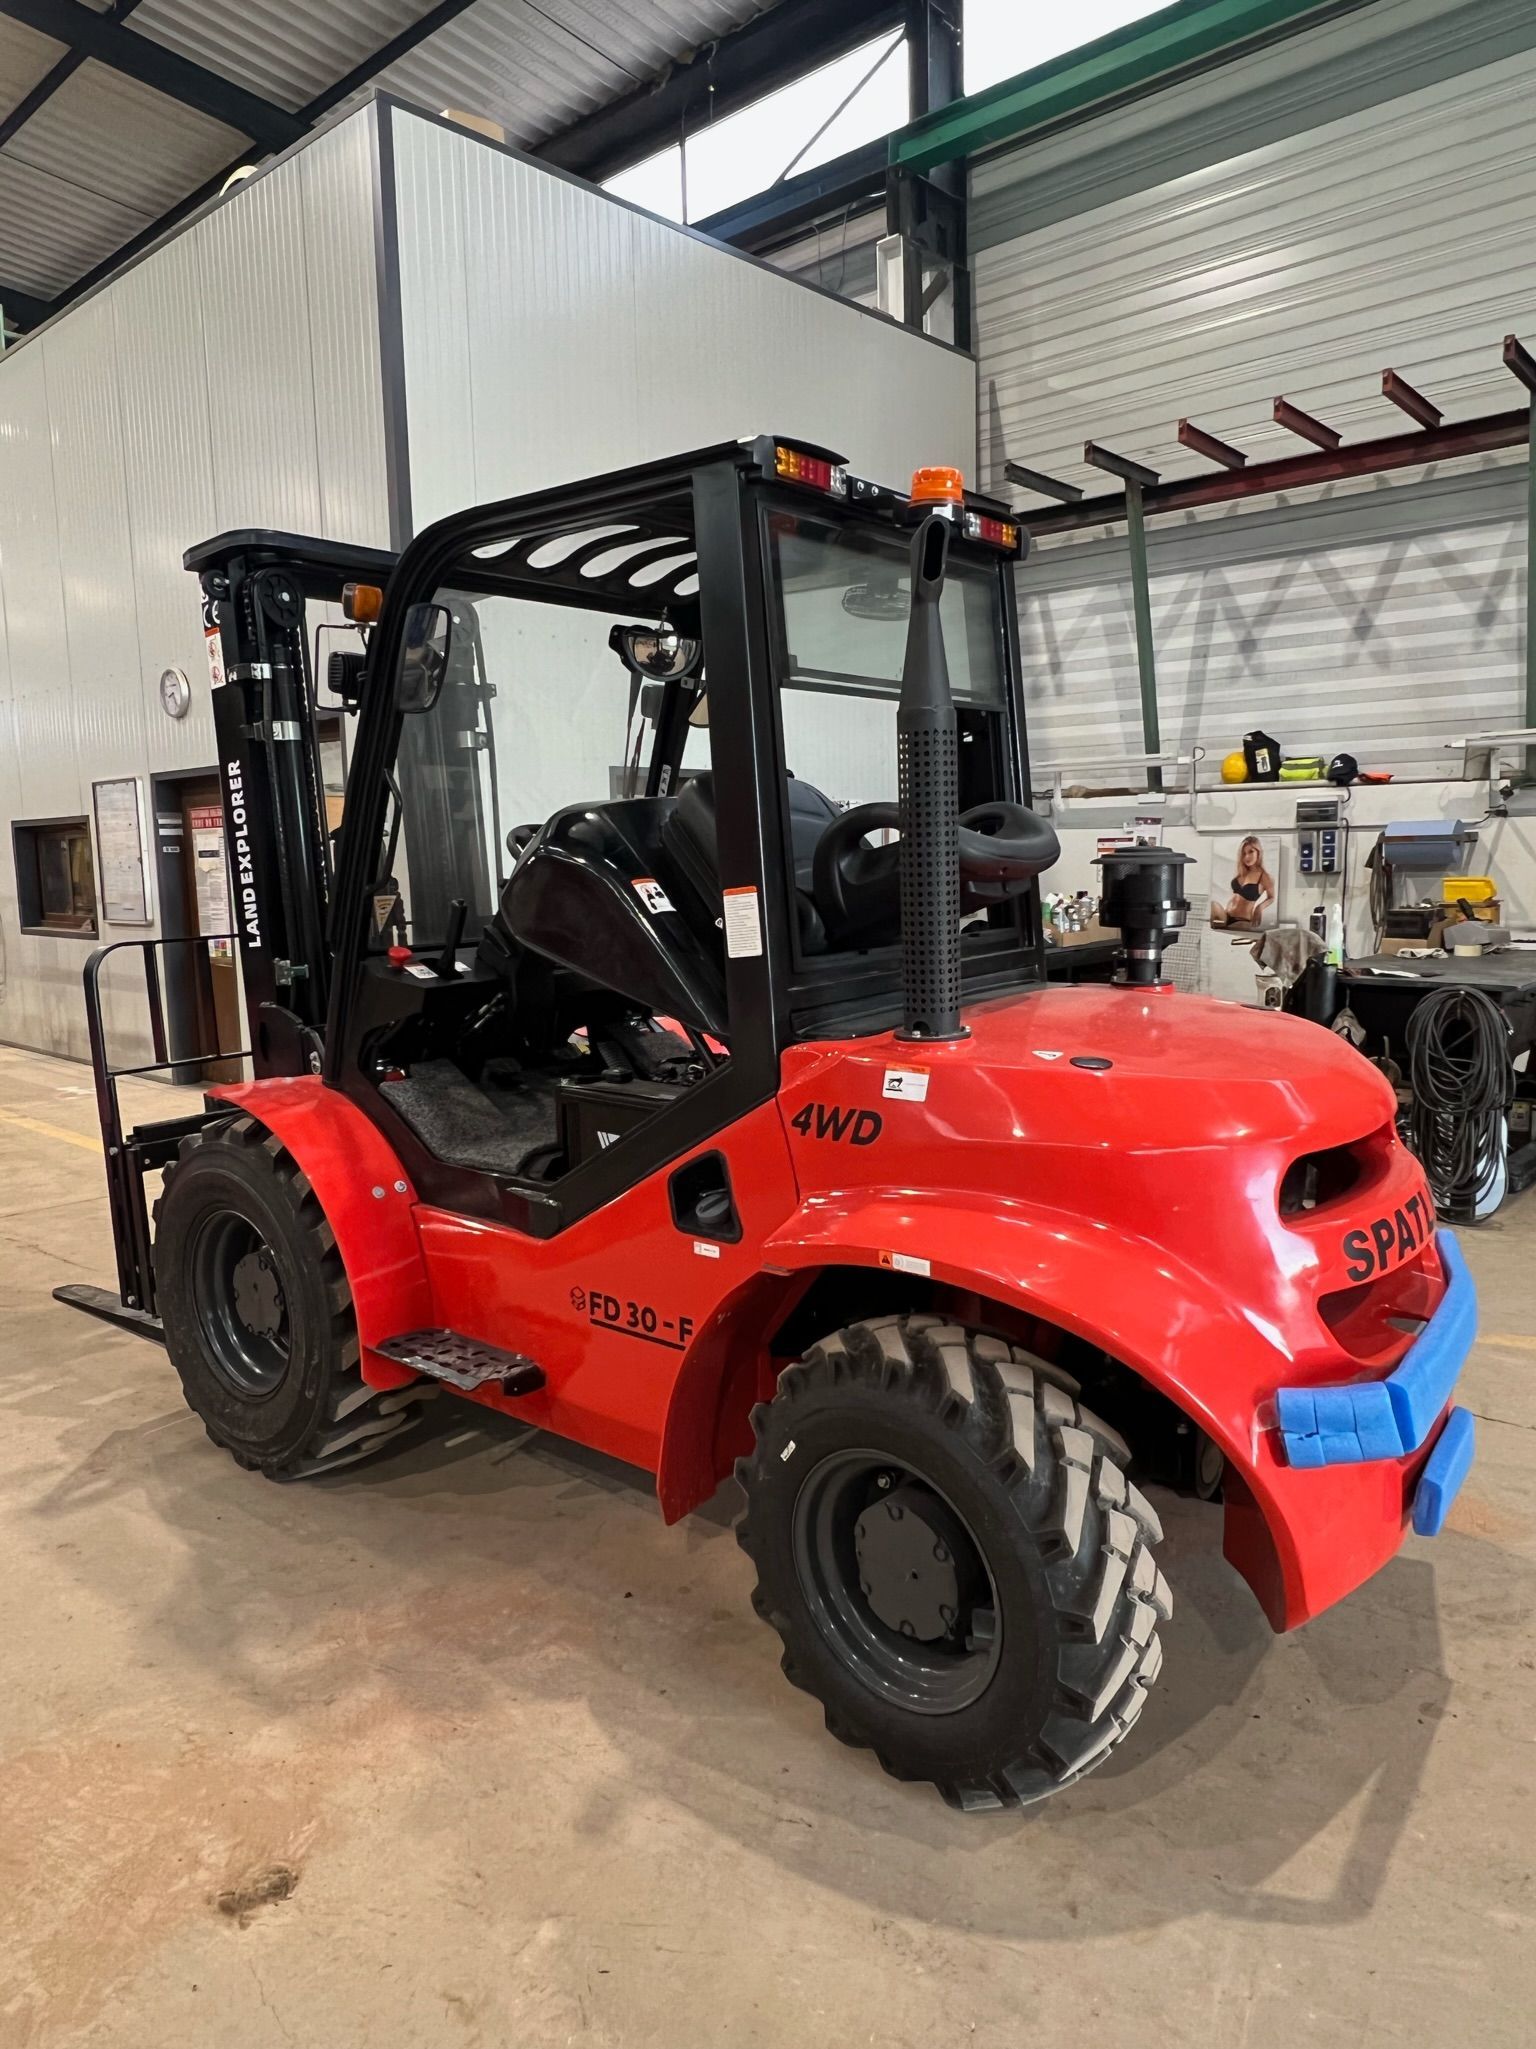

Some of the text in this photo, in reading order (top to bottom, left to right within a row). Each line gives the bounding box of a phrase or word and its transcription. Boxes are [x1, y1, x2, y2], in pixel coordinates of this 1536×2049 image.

[227, 760, 262, 948] LAND EXPLORER
[791, 1102, 882, 1146] 4WD
